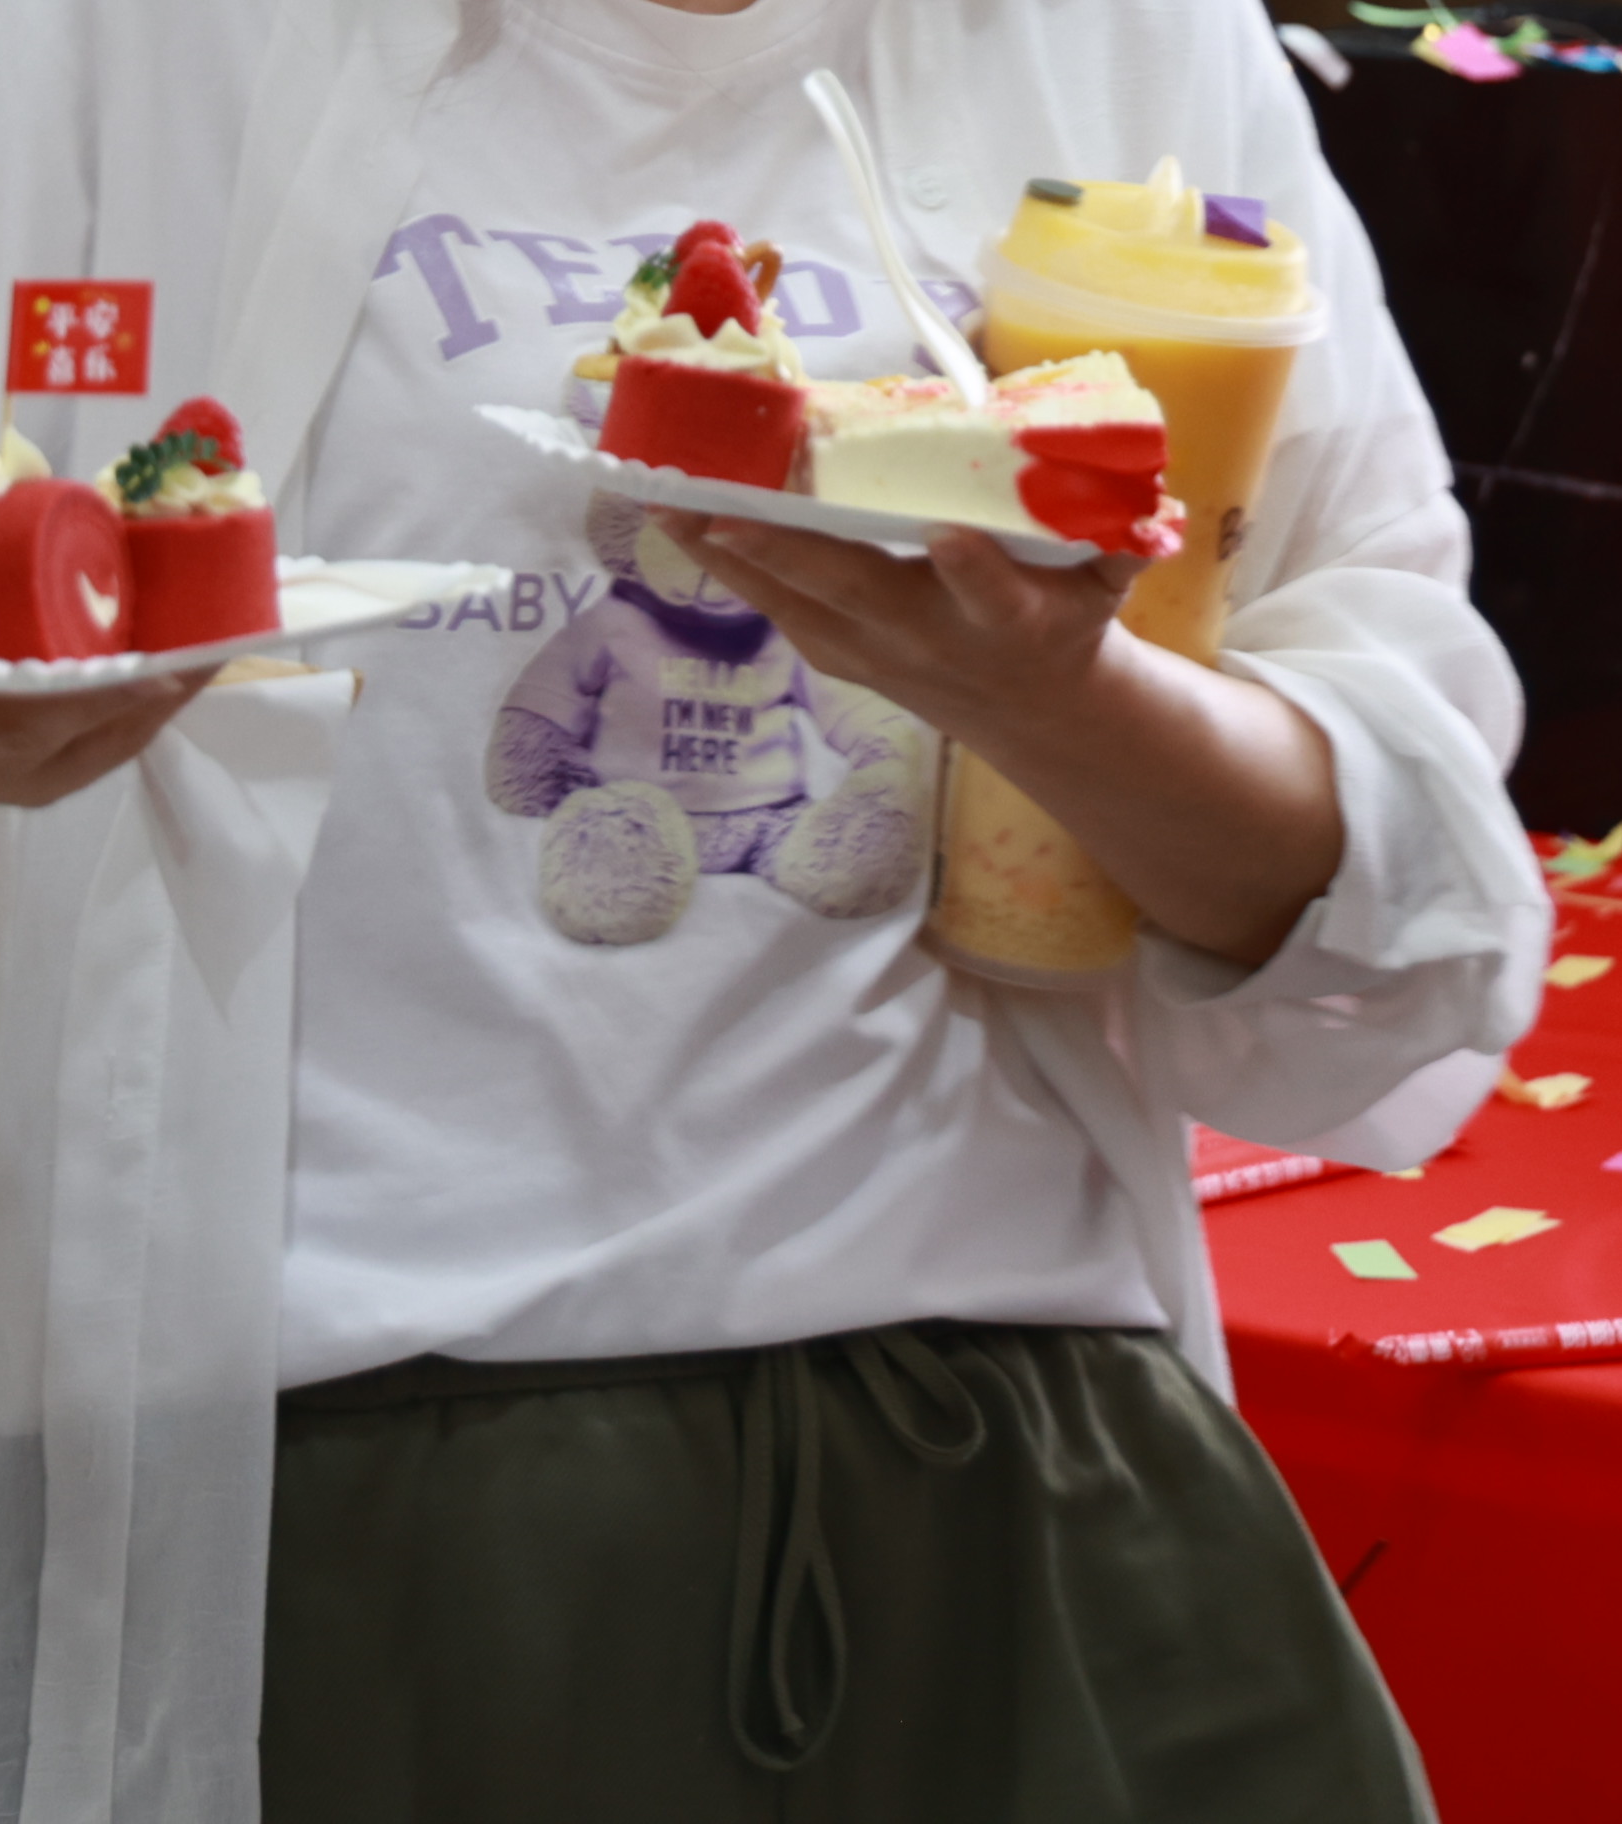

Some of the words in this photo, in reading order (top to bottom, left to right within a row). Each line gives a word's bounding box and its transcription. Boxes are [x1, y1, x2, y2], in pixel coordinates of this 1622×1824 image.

[374, 213, 985, 376] TED
[46, 298, 120, 340] 平安
[701, 701, 755, 737] NEW
[660, 732, 739, 775] HERE
